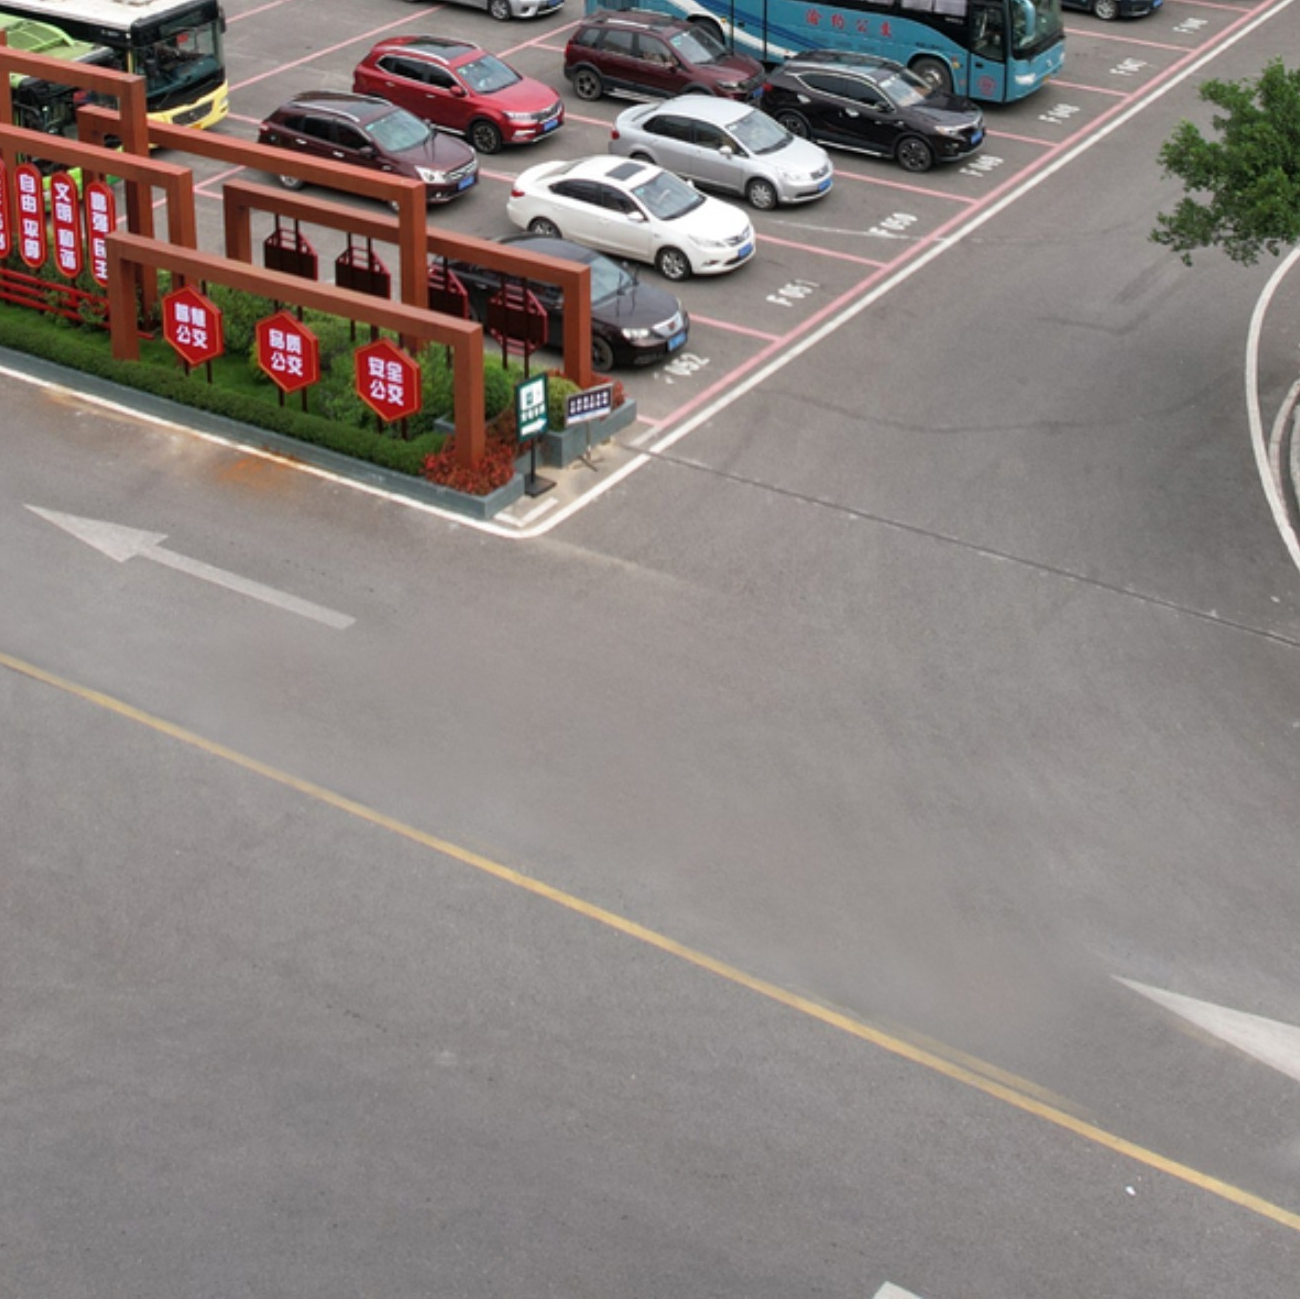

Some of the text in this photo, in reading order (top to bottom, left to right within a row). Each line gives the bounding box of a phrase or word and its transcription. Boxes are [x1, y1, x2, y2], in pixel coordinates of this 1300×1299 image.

[54, 182, 77, 270] 文明和谐
[176, 325, 208, 350] 公交
[268, 328, 302, 355] 品质
[271, 352, 304, 377] 公交
[368, 356, 404, 384] 安全
[370, 379, 406, 406] 公交
